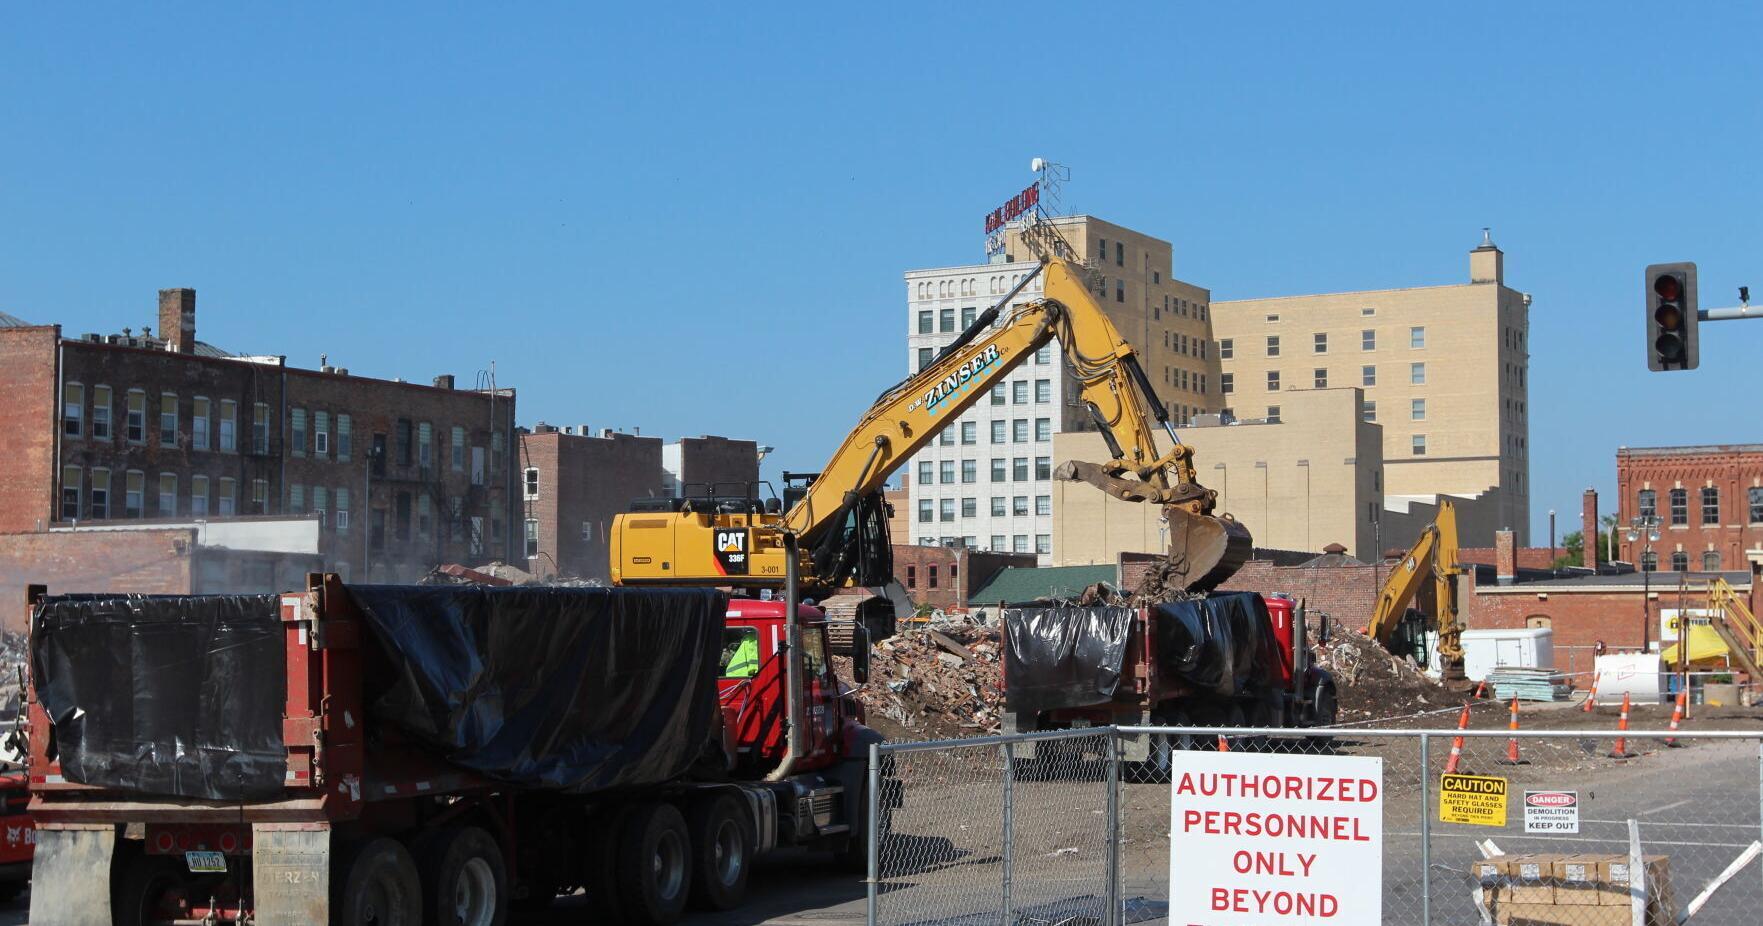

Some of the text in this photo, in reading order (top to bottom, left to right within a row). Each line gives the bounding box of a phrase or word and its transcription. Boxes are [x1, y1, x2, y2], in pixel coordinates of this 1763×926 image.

[925, 343, 999, 410] ZINSER
[718, 532, 745, 552] CAT
[728, 554, 745, 563] 336F
[761, 566, 779, 574] 3-001
[1176, 772, 1378, 802] AUTHORIZED
[1444, 778, 1504, 793] CAUTION
[1471, 801, 1503, 809] GLASSES
[1532, 796, 1570, 804] DANGER
[1452, 806, 1494, 815] REQUIRED
[1184, 810, 1370, 841] PERSONNEL
[1233, 850, 1317, 877] ONLY
[1211, 887, 1338, 918] BEYOND
